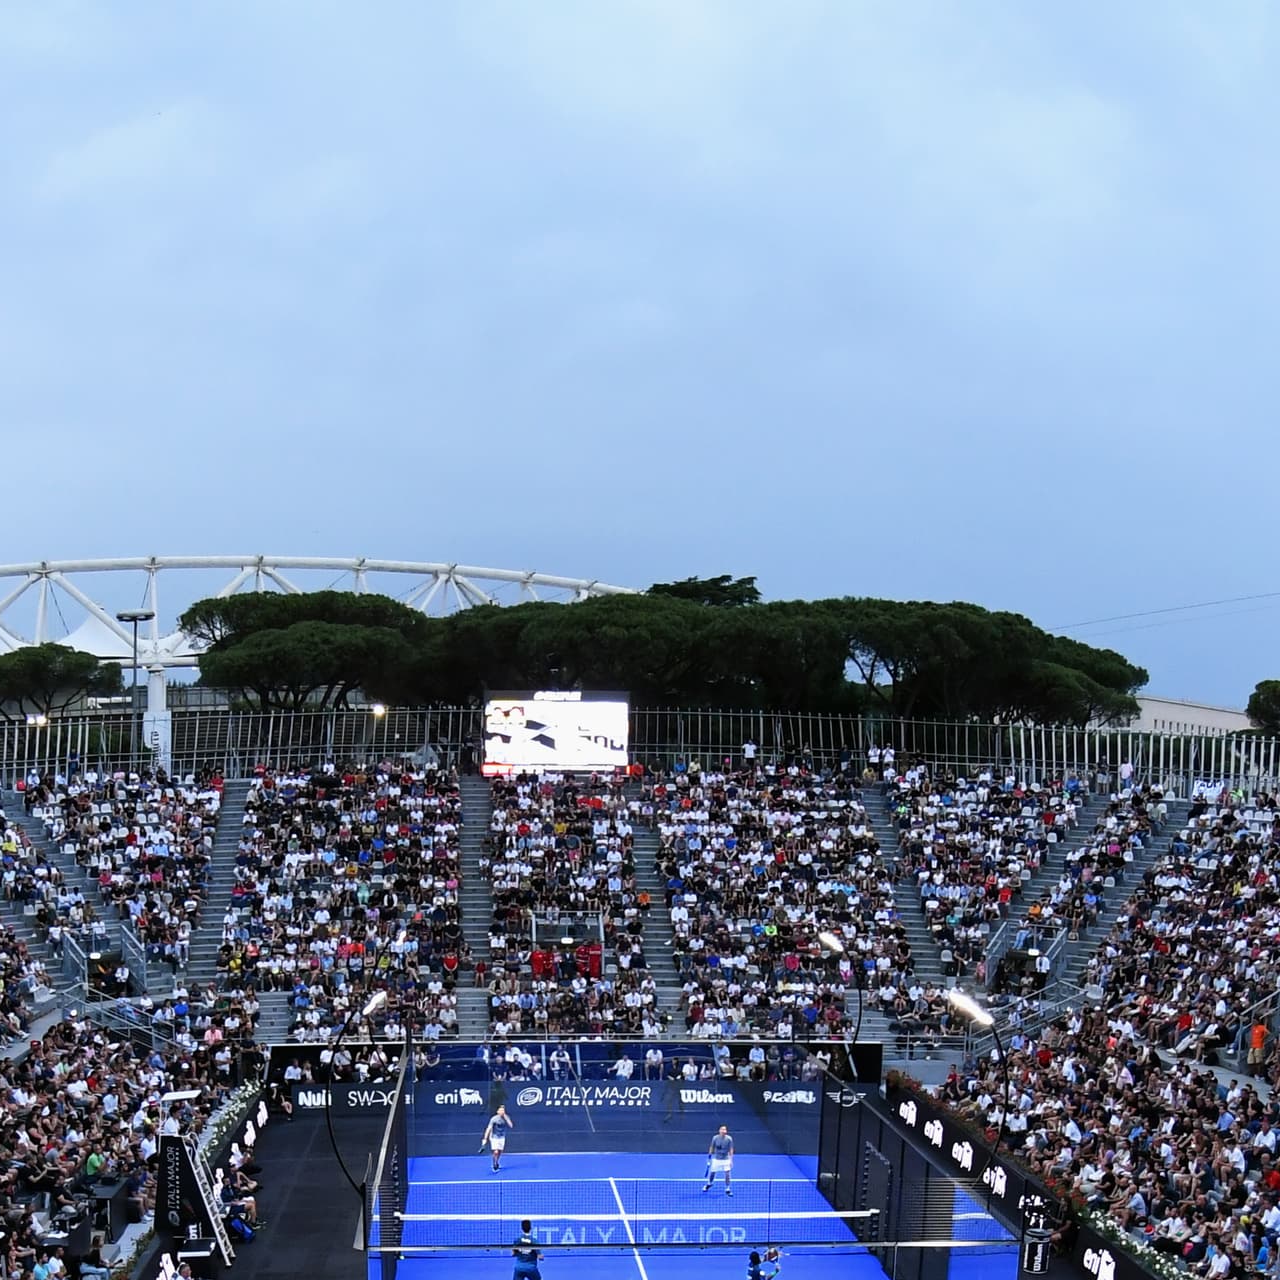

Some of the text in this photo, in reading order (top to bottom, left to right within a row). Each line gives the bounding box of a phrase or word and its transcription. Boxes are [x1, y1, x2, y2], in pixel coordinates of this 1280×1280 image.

[546, 1086, 652, 1100] ITALY MAJOR
[680, 1089, 735, 1104] Wilson
